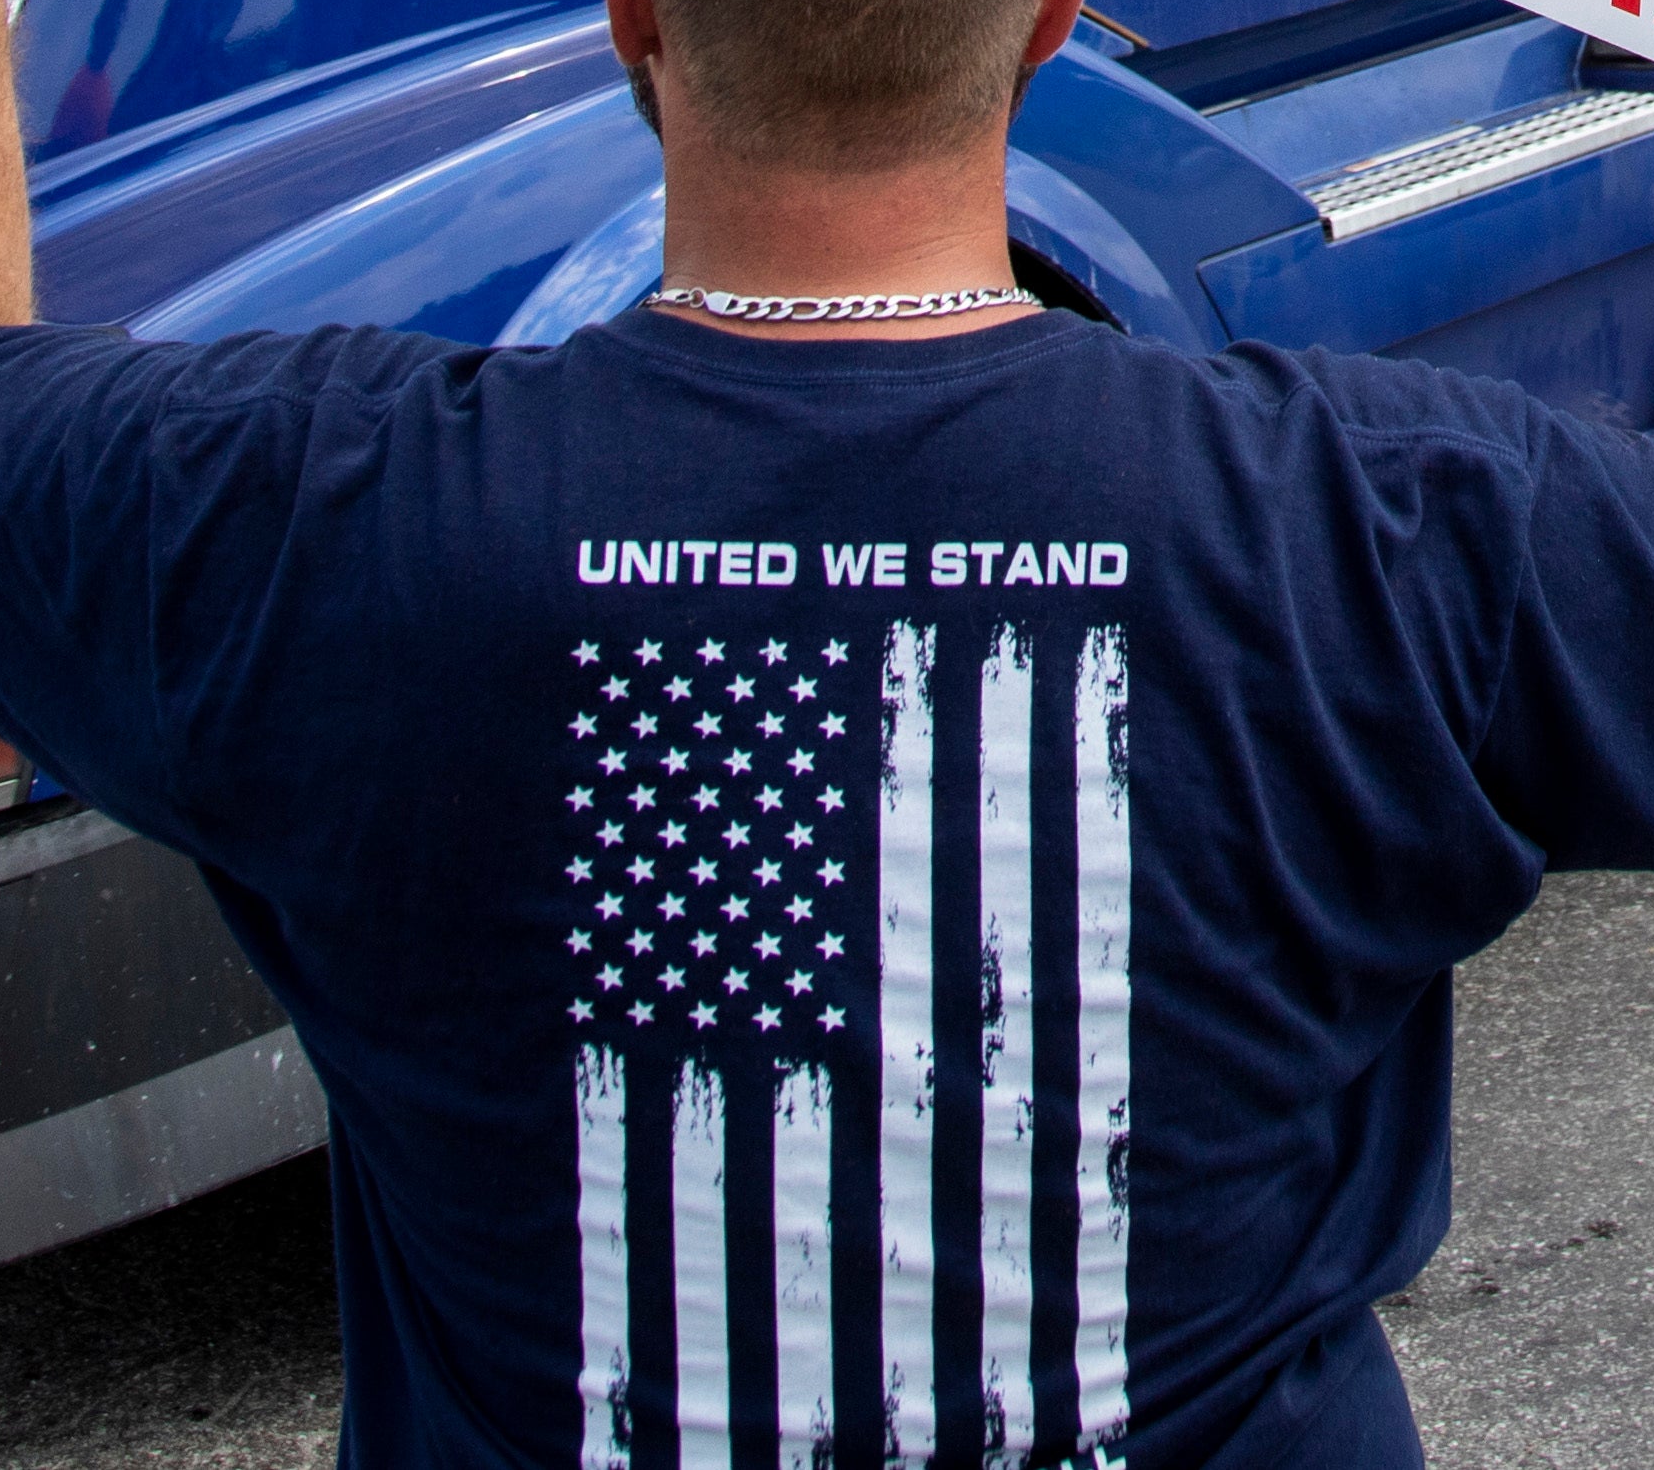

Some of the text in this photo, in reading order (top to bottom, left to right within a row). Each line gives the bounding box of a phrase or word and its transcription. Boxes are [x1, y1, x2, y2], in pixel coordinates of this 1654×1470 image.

[578, 540, 1129, 586] UNITED WE STAND
